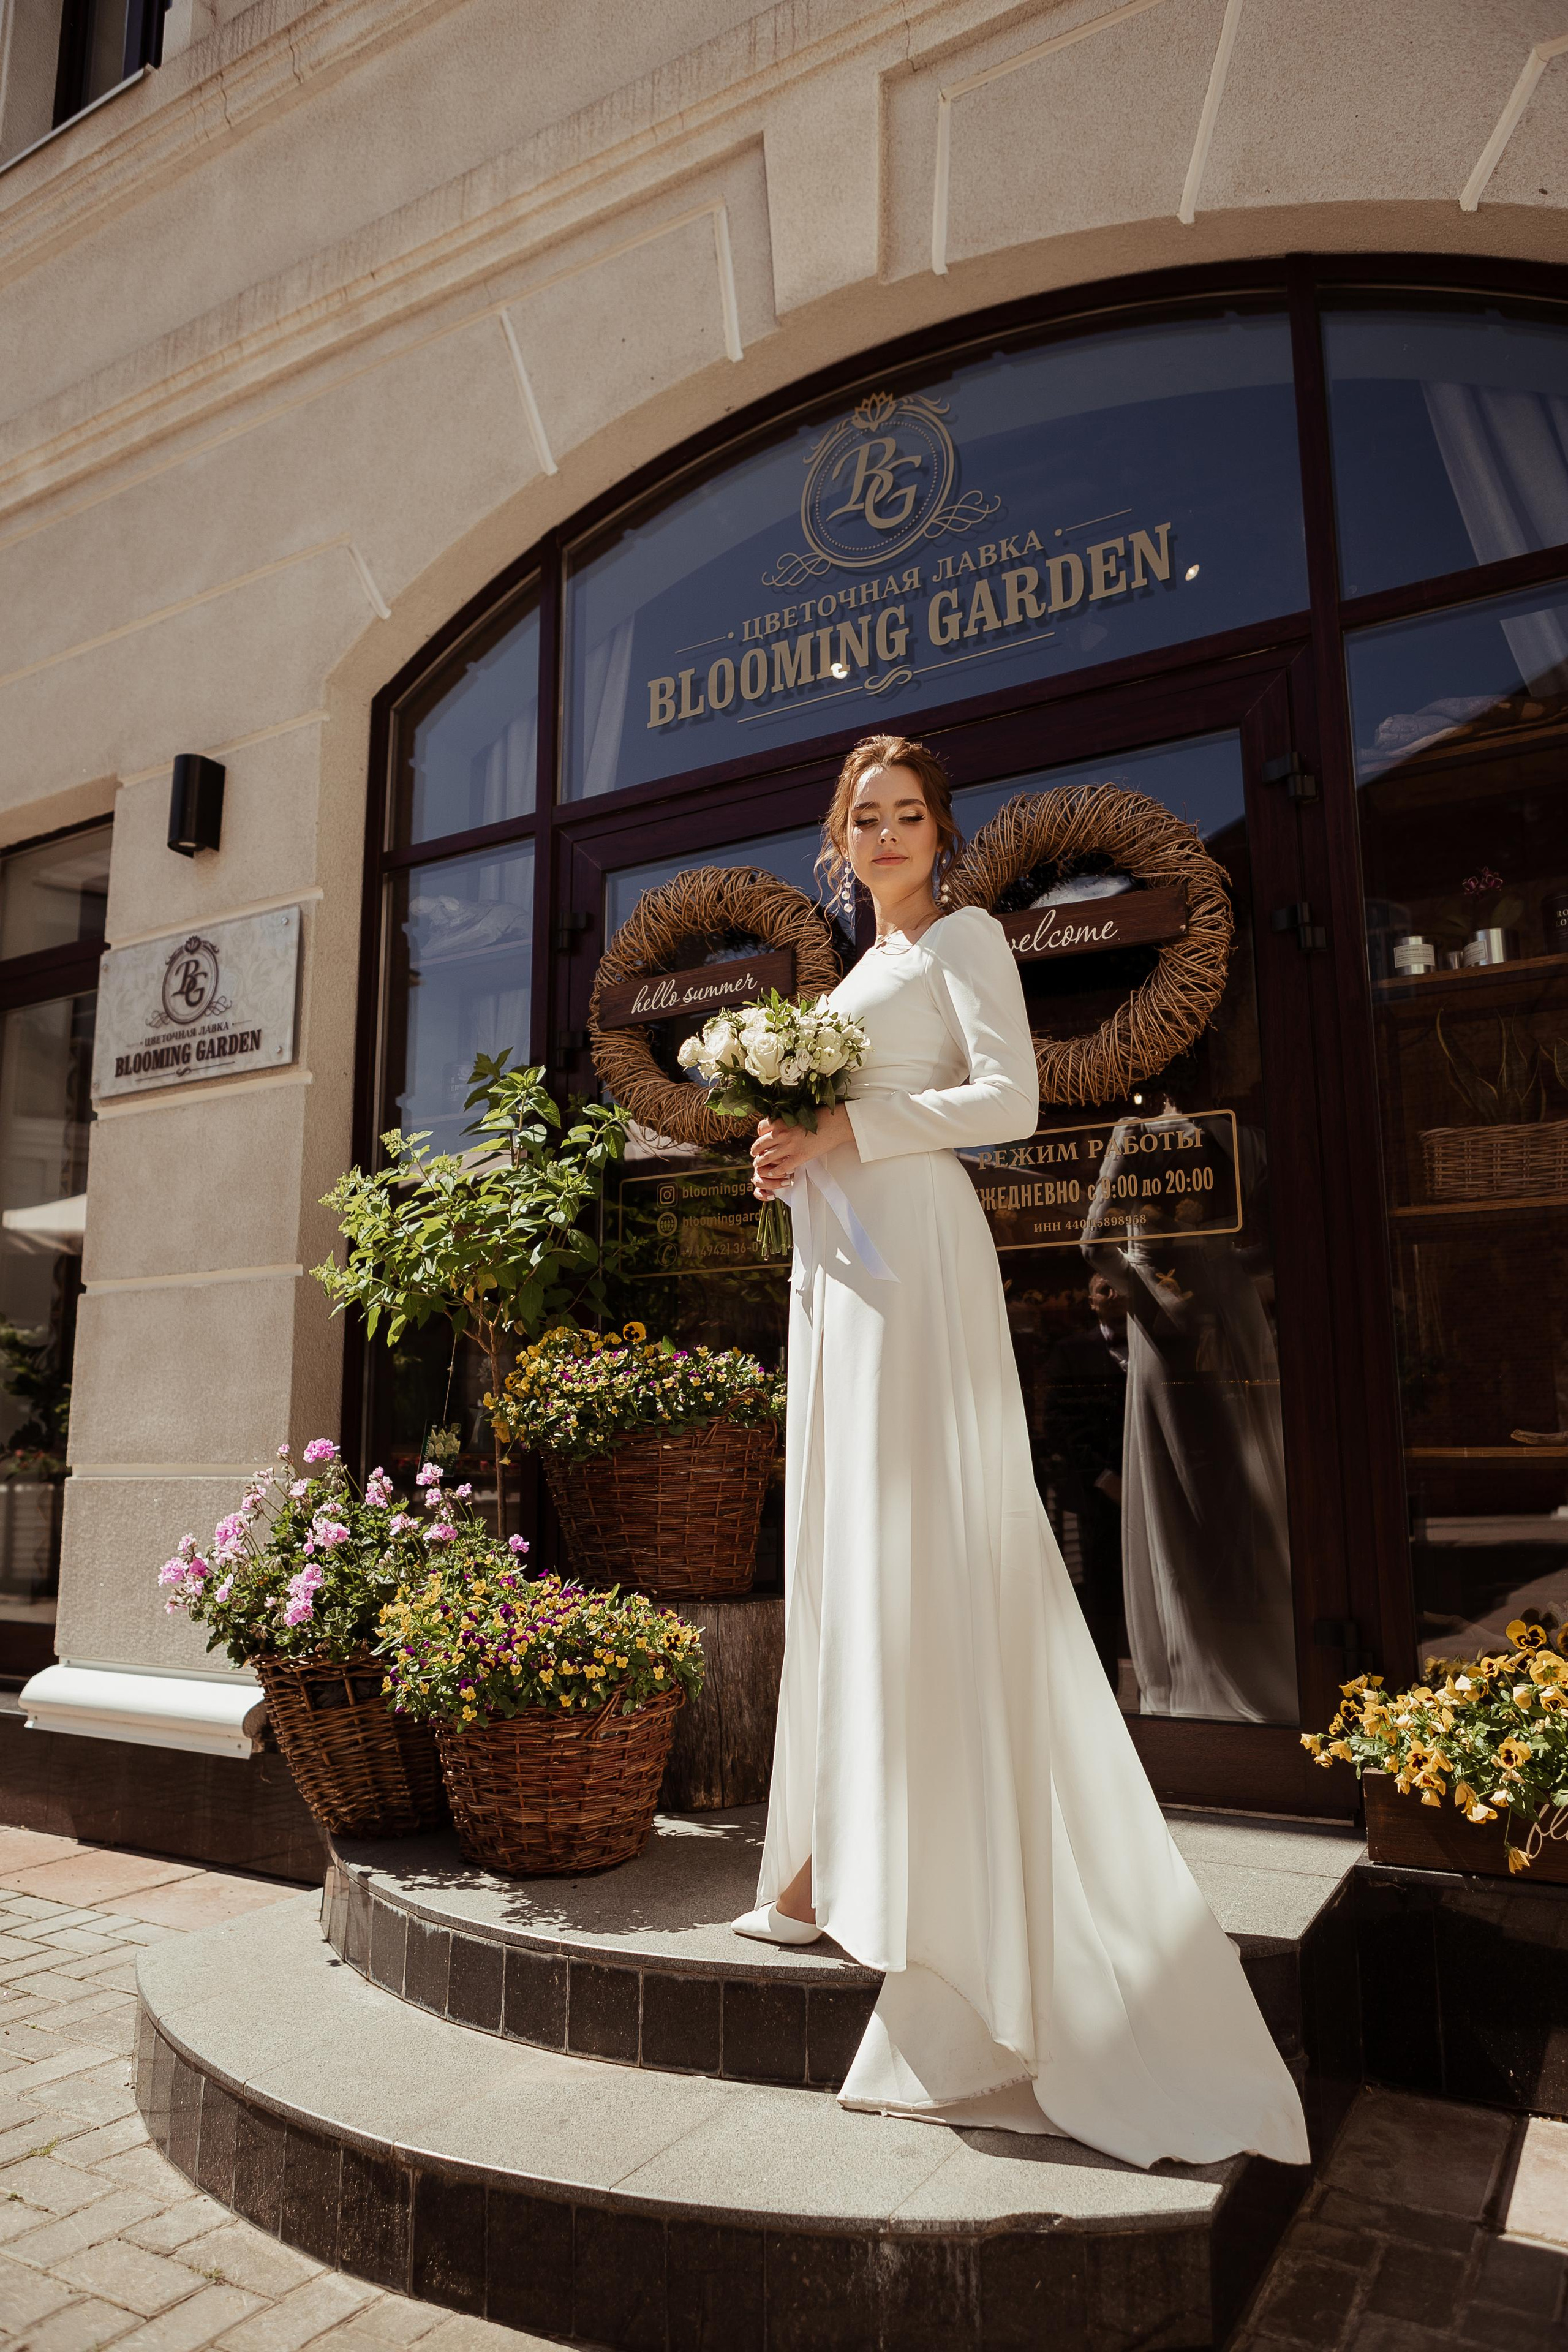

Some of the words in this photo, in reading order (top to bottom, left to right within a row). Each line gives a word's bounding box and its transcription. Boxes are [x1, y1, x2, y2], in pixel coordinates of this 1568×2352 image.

[742, 567, 921, 643] ЦВЕТОЧНАЯ
[932, 529, 1044, 582] ЛАВКА
[647, 605, 910, 729] BLOOMING
[928, 522, 1172, 647] GARDEN
[631, 979, 680, 1014] hello
[683, 973, 758, 1003] summer
[115, 1042, 191, 1077] BLOOMING
[196, 1029, 262, 1061] GARDEN
[145, 1028, 196, 1047] ЦВЕТОЧНАЯ
[198, 1022, 229, 1036] ЛАВКА
[978, 1142, 1079, 1170] РЕЖИМ
[1088, 1128, 1203, 1158] РАБОТЫ
[682, 1182, 753, 1199] bloomingga
[976, 1179, 1080, 1210] ЖЕДНЕВНО
[1102, 1174, 1137, 1200] 9:00
[1142, 1178, 1161, 1197] до
[1166, 1167, 1213, 1194] 20:00
[682, 1208, 761, 1227] bloominggard
[1033, 1221, 1061, 1232] ИНН
[734, 1241, 760, 1254] 36-0
[1526, 1803, 1568, 1860] fl
